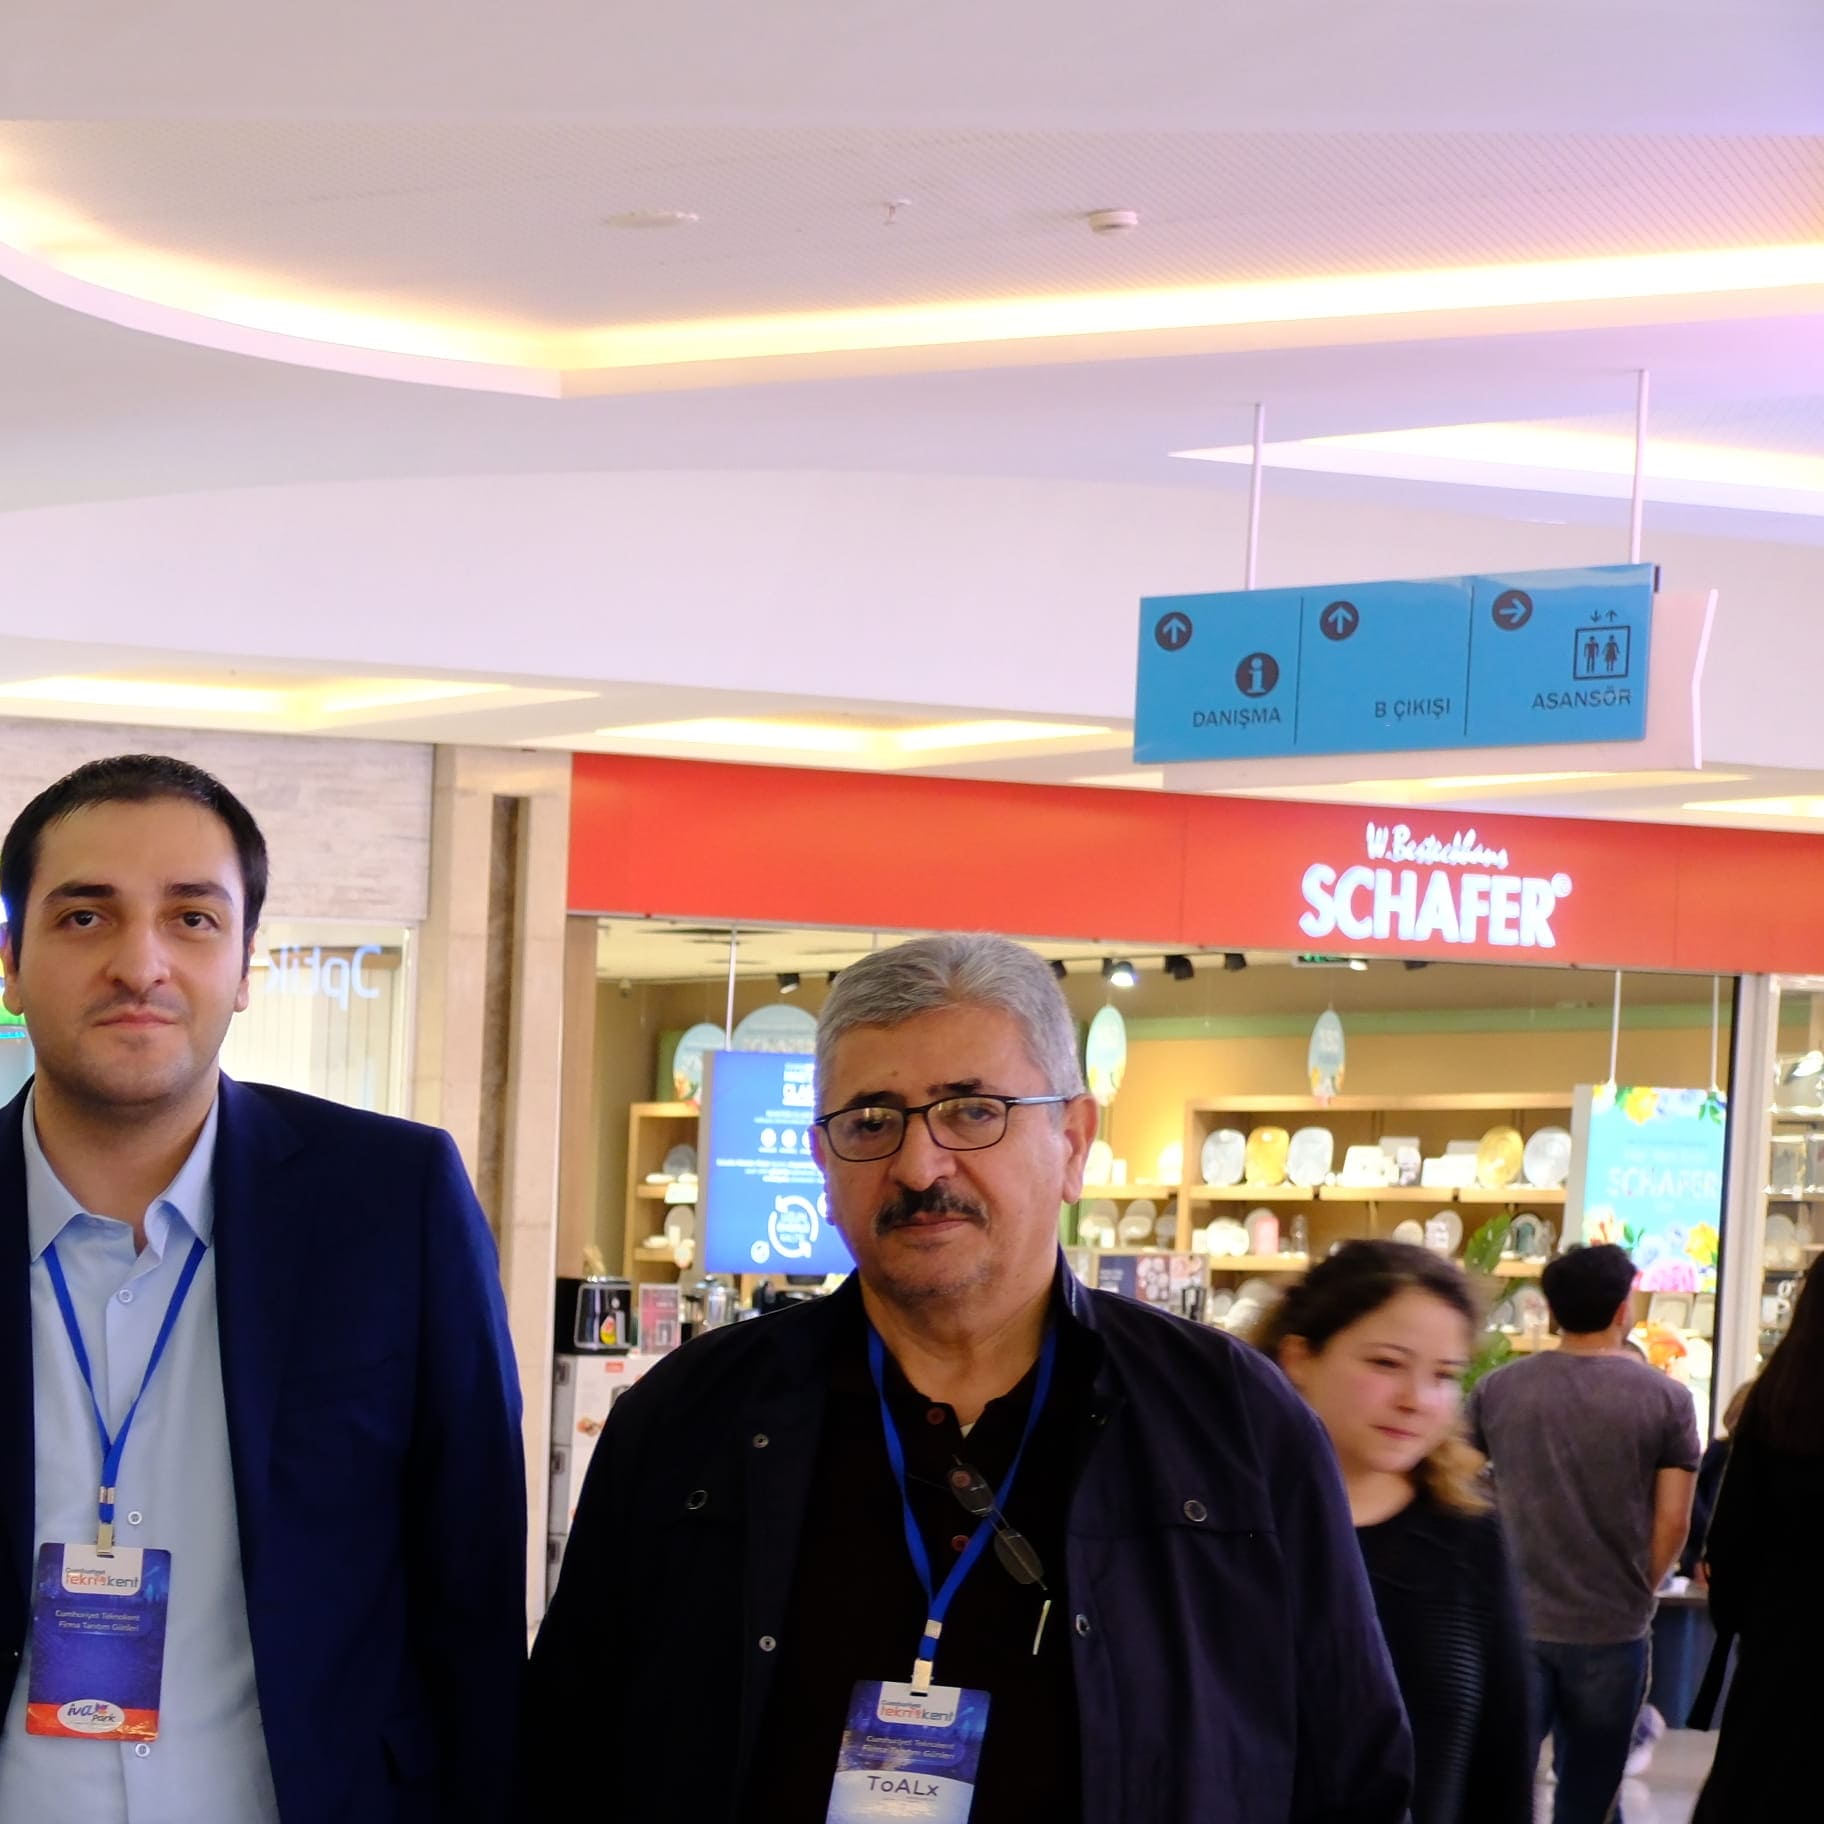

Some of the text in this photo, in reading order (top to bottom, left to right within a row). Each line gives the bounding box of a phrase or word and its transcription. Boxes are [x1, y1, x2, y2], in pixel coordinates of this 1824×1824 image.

[1374, 698, 1451, 722] B ÇIKIŞI
[1530, 687, 1633, 711] ASANSÖR
[1192, 708, 1282, 730] DANIŞMA
[867, 1775, 940, 1797] ToALx
